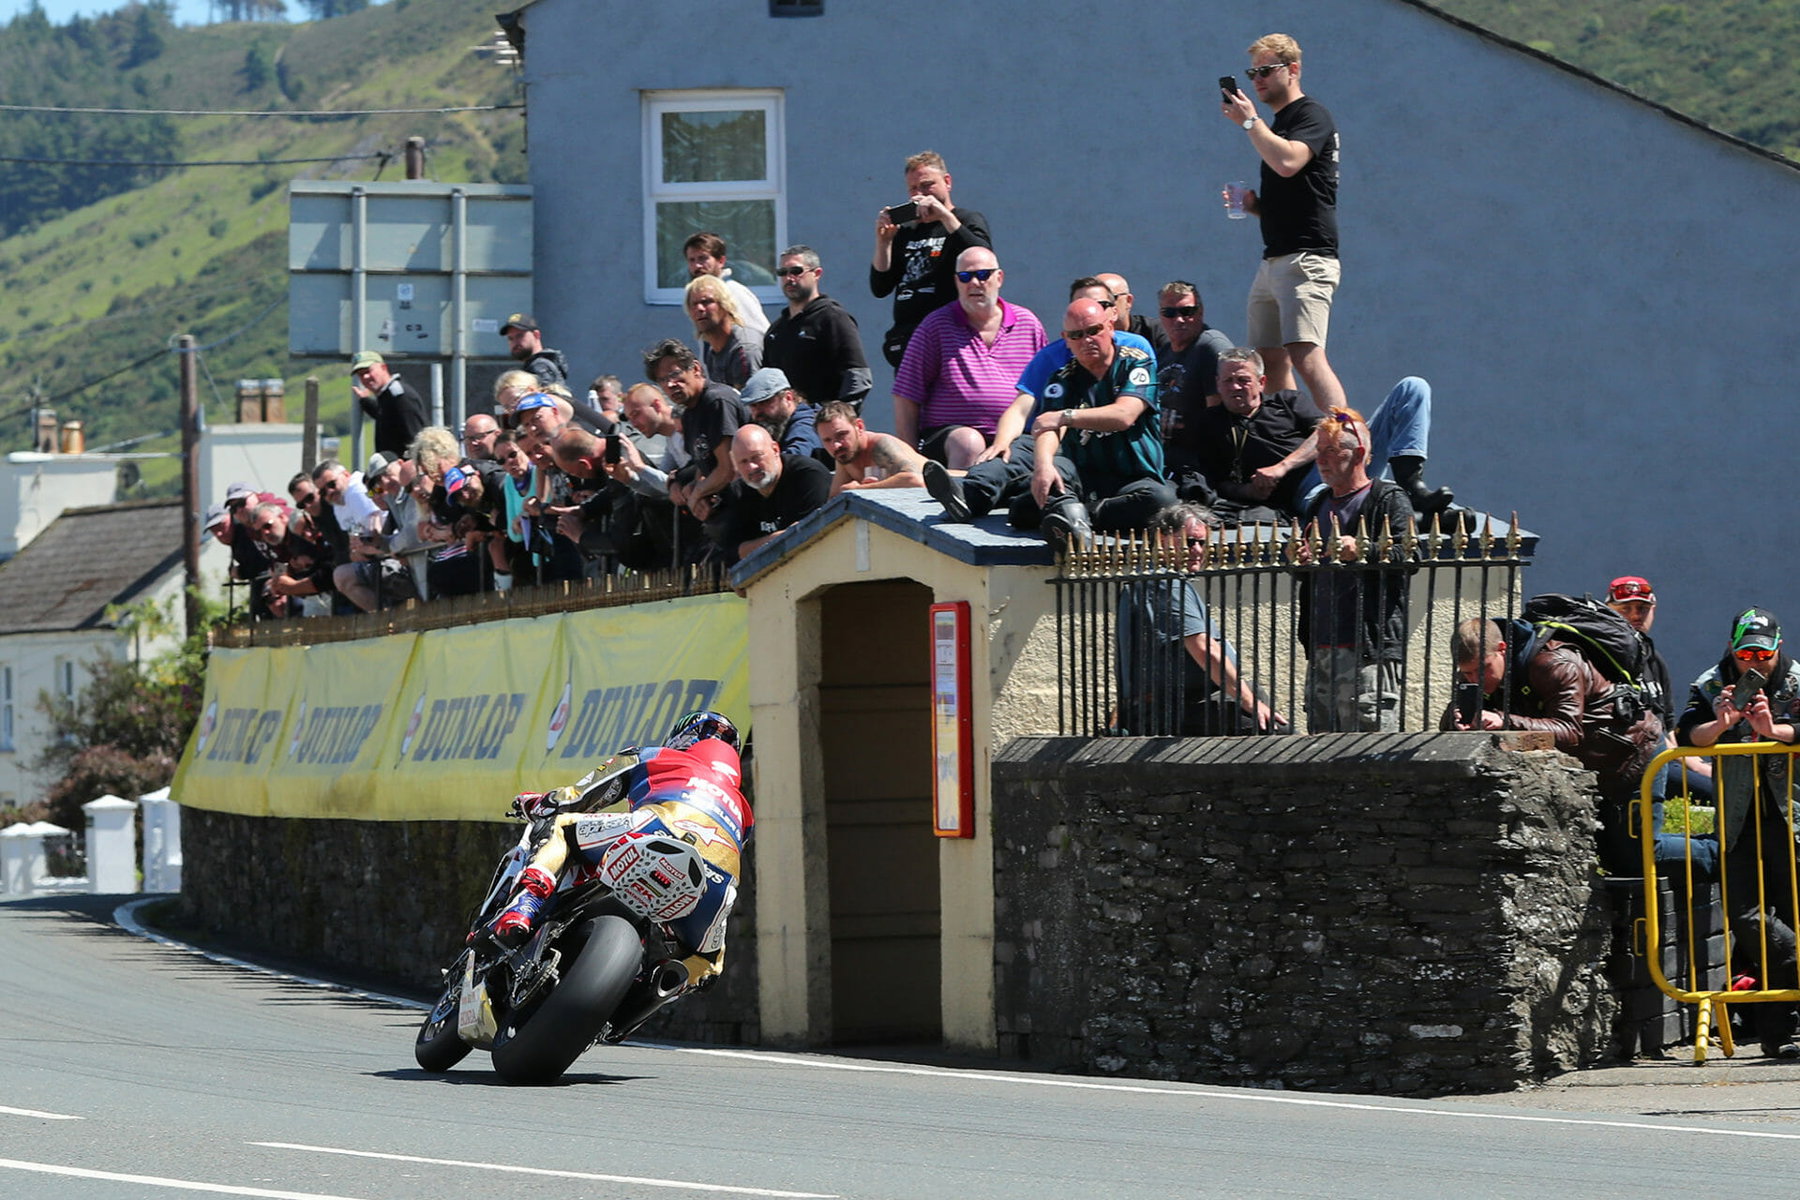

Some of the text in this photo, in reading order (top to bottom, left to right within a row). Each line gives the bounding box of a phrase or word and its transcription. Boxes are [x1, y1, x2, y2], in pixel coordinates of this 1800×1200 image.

[412, 693, 526, 762] DUNLOP
[609, 849, 639, 880] MOTUL
[659, 858, 685, 880] MOTUL
[631, 882, 655, 901] RK
